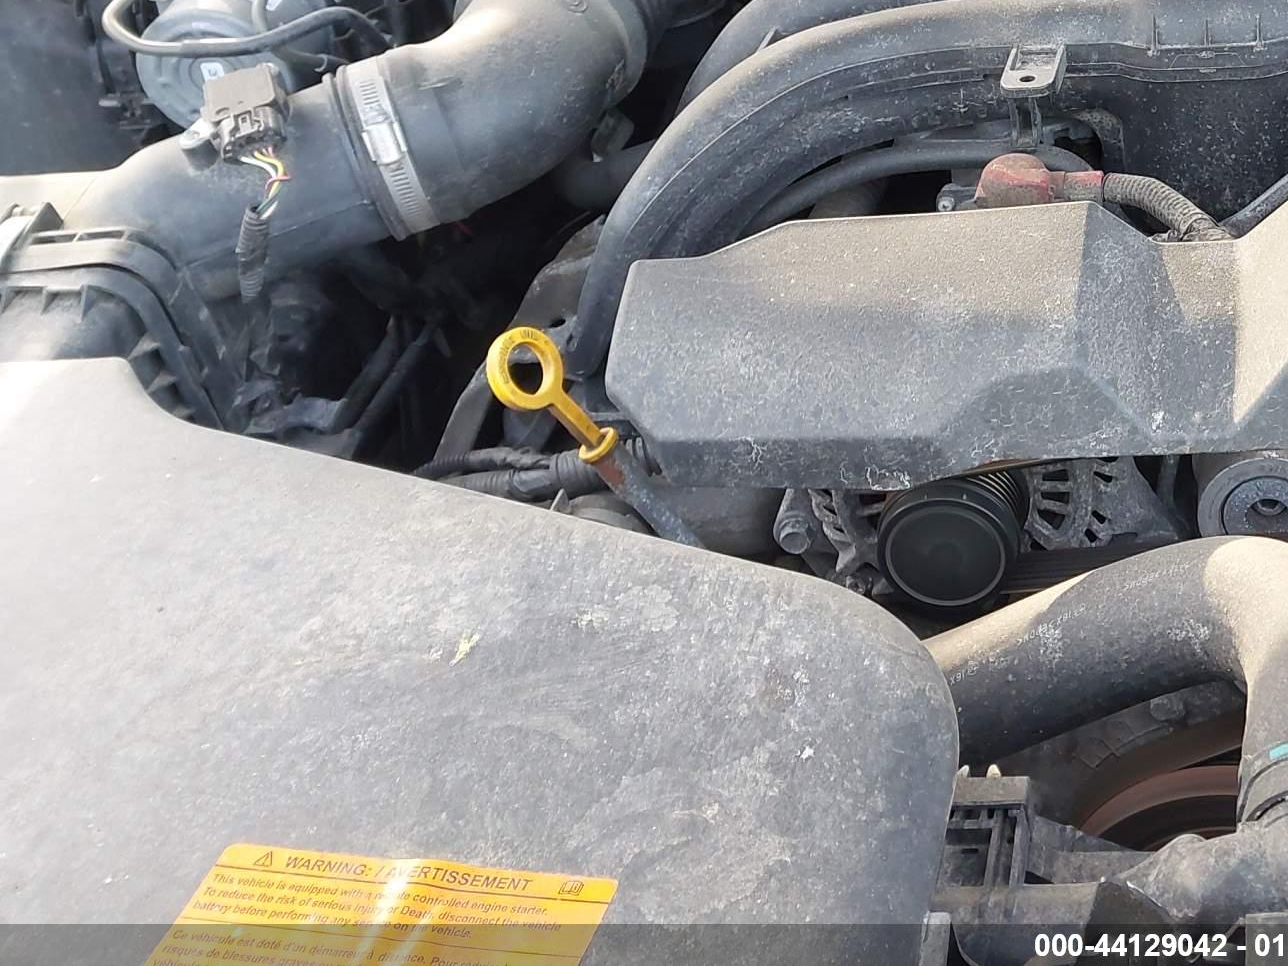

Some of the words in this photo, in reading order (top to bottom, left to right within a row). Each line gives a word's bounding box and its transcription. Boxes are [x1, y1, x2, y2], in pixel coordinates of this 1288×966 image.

[285, 856, 372, 877] WARNING:
[385, 865, 533, 891] AVERTISSEMENT
[203, 886, 216, 896] To
[217, 888, 255, 900] reduce
[256, 892, 274, 903] the
[275, 895, 296, 906] risk
[298, 897, 312, 907] of
[312, 899, 352, 911] serious
[438, 911, 501, 926] disconnect
[502, 918, 520, 928] the
[522, 920, 562, 932] vehicle
[213, 873, 235, 884] This
[237, 878, 274, 889] vehicle
[276, 881, 287, 890] is
[288, 884, 338, 896] equipped
[340, 888, 362, 898] with
[412, 893, 469, 908] controlled
[470, 901, 508, 914] engine
[511, 904, 548, 916] starter.
[193, 900, 231, 914] battery
[232, 903, 268, 916] before
[267, 908, 329, 923] performing
[393, 922, 409, 932] on
[431, 925, 472, 938] vehicle.
[173, 929, 189, 939] Ce
[238, 937, 255, 947] est
[206, 948, 220, 959] de
[222, 950, 277, 964] blessures
